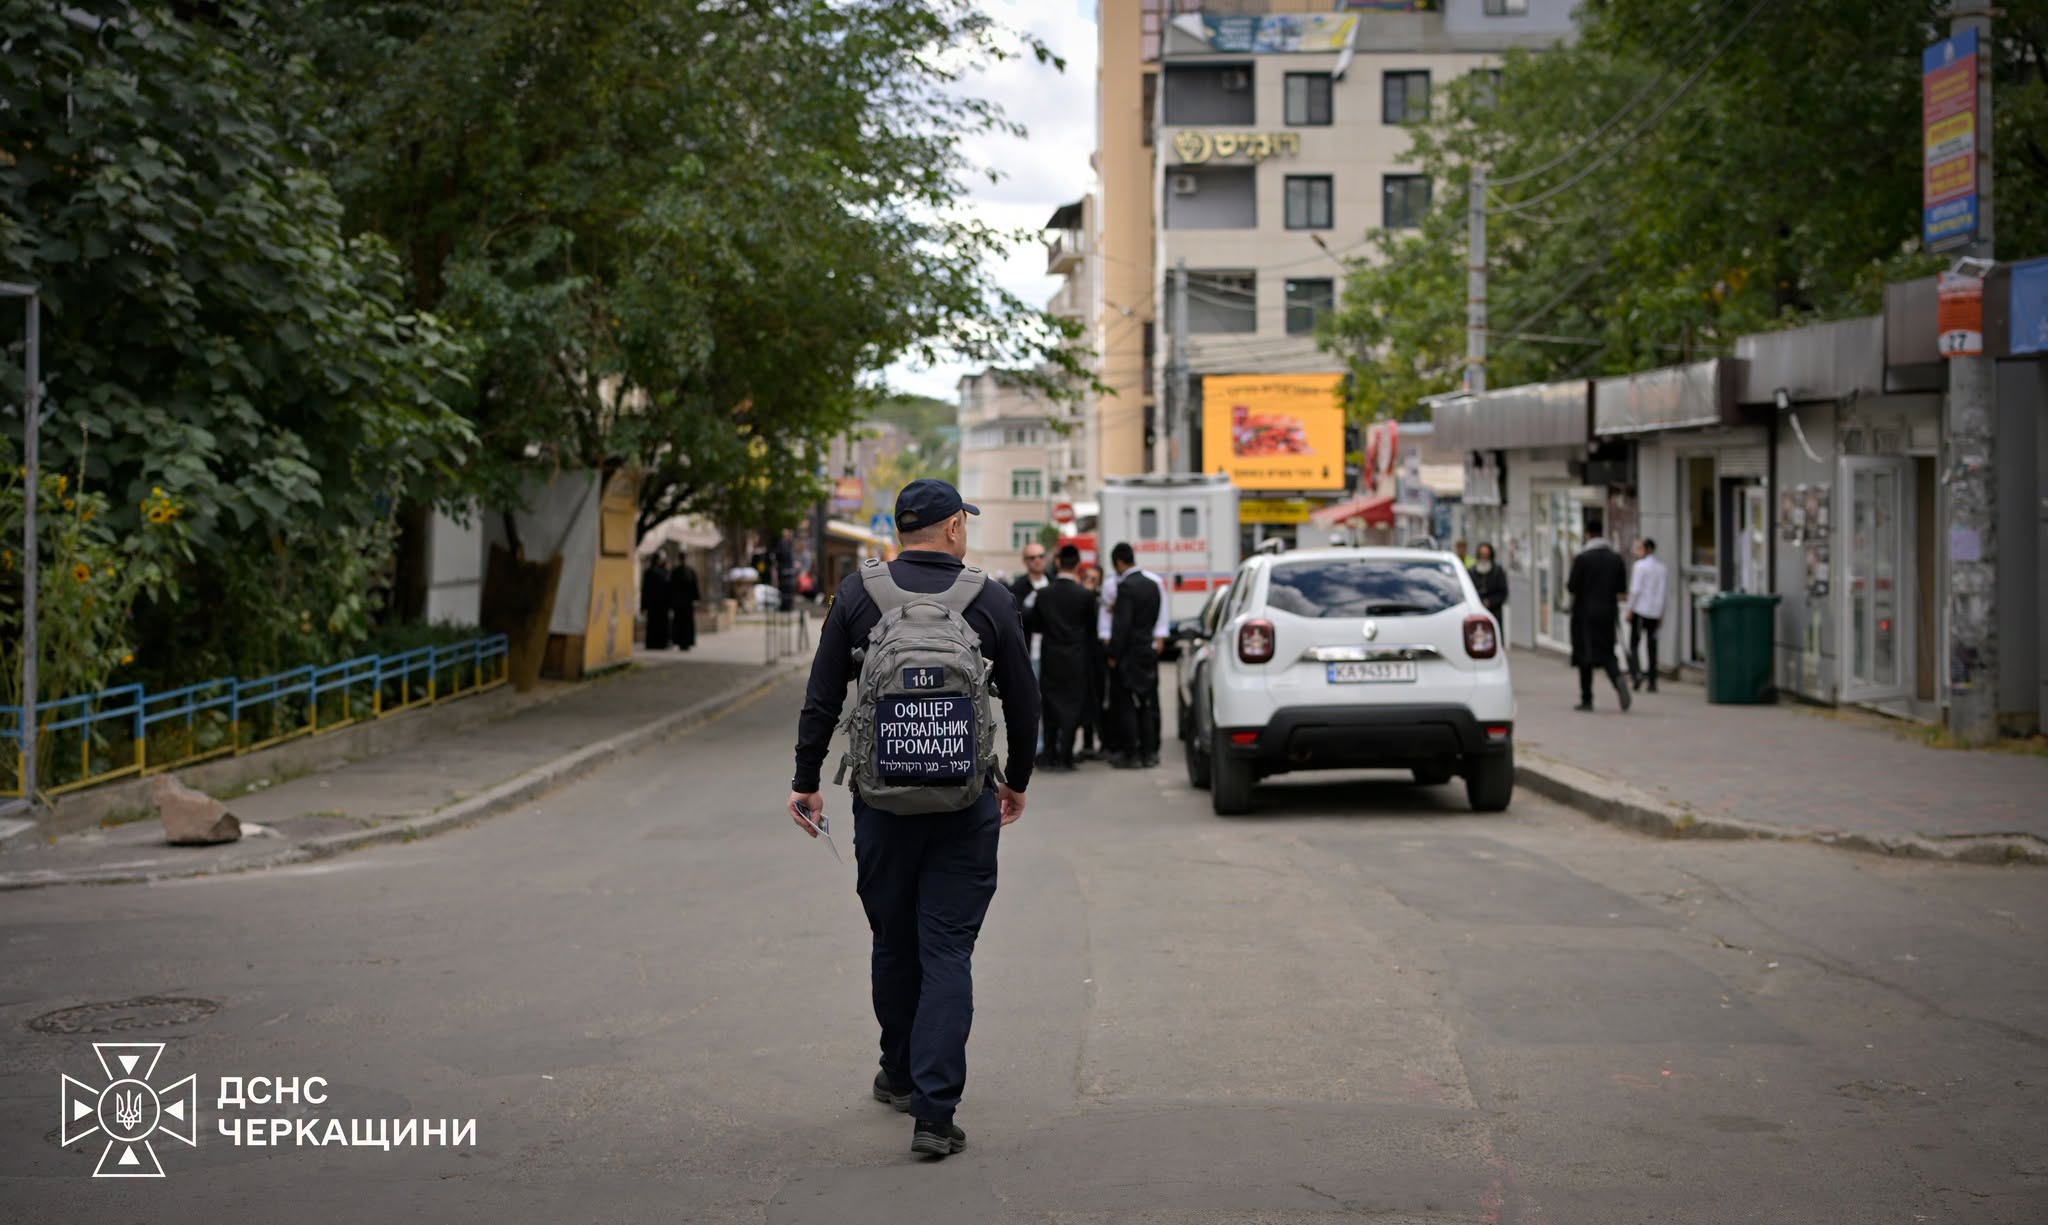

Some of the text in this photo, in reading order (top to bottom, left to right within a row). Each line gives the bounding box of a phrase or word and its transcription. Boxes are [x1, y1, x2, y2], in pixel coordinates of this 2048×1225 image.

[912, 674, 934, 687] 101
[894, 701, 953, 721] ОФІЦЕР
[880, 720, 969, 738] РЯТУВАЛЬНИК
[886, 737, 964, 758] ГРОМАДИ
[949, 760, 971, 774] קצין
